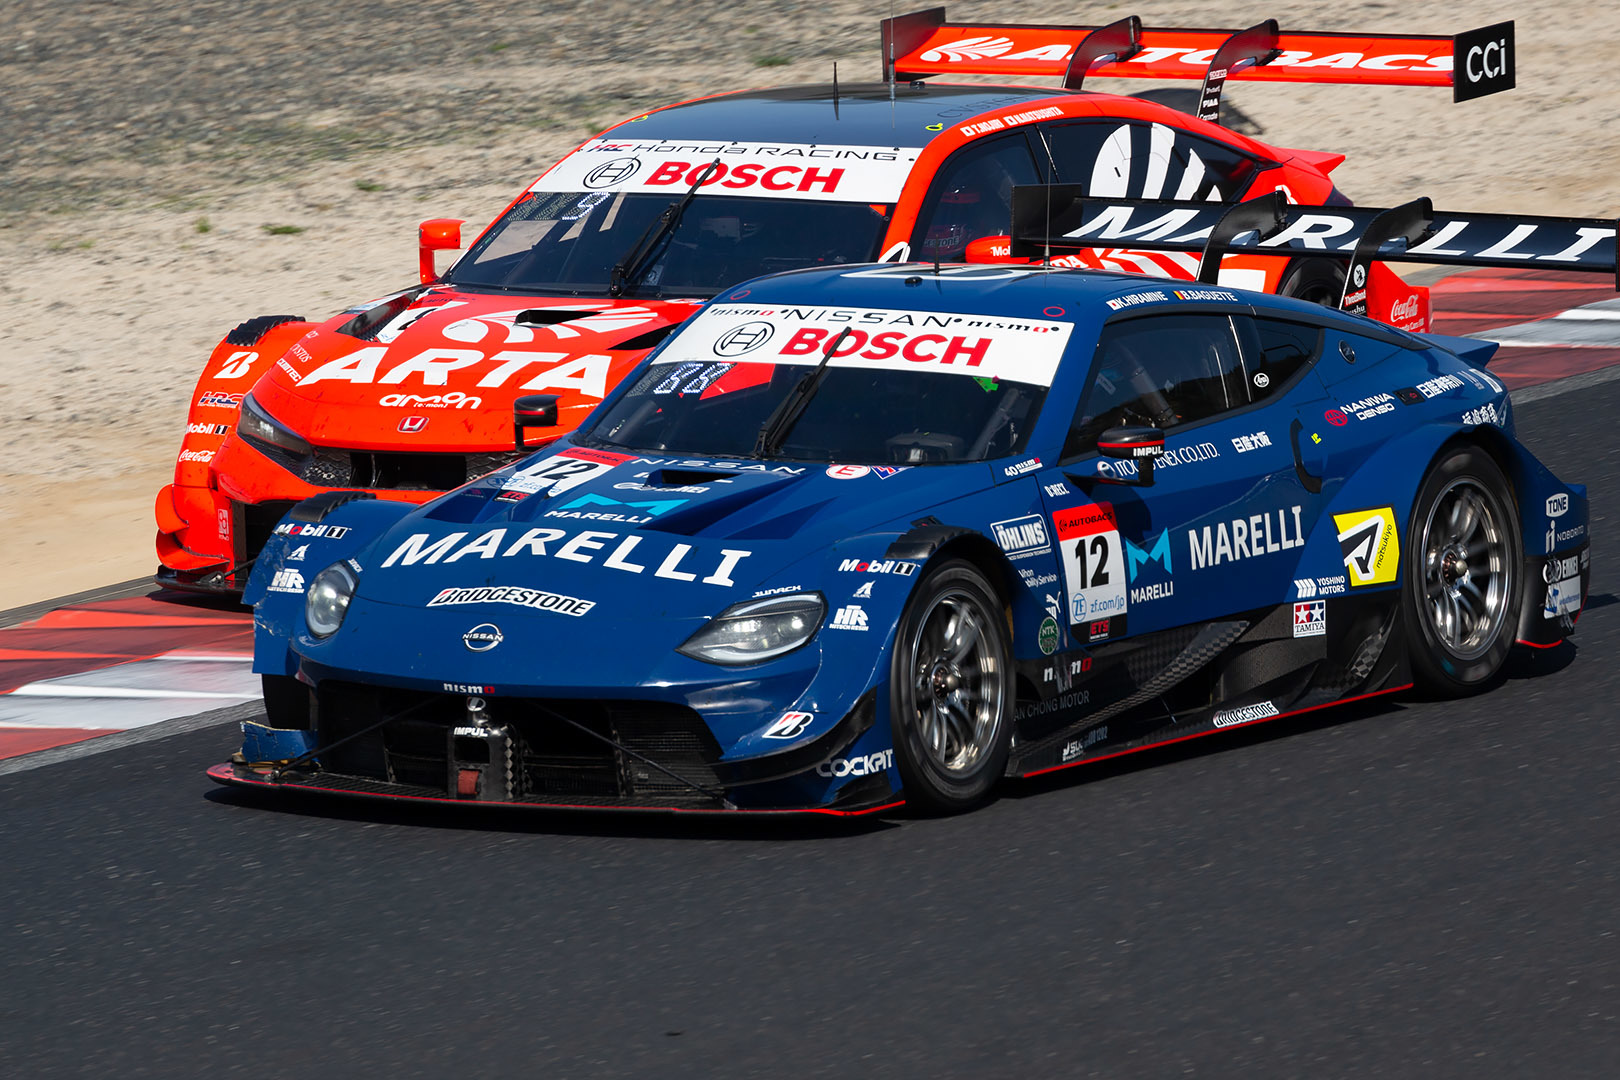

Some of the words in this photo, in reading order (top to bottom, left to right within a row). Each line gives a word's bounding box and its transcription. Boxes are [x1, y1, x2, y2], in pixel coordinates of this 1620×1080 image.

[632, 143, 748, 155] Honda
[755, 146, 898, 162] RACING
[643, 160, 846, 194] BOSCH
[1116, 290, 1169, 308] K.HIRAMINE
[1181, 290, 1239, 302] B.BAGUETTE
[786, 308, 957, 328] NISSAN
[967, 320, 1049, 334] nismo
[778, 327, 993, 367] BOSCH
[295, 346, 613, 399] ARTA
[1340, 392, 1396, 416] NANIWA
[1355, 402, 1396, 421] DENSO
[1133, 446, 1164, 457] IMPUL
[1231, 431, 1273, 454] 日産大阪
[530, 459, 600, 481] 12
[631, 457, 807, 475] NISSAN
[1547, 496, 1567, 515] TONE
[544, 510, 653, 524] MARELLI
[1068, 511, 1113, 529] AUTOBACS
[273, 523, 328, 537] Mobil
[995, 522, 1046, 551] ÖHLINS
[1189, 505, 1305, 571] MARELLI
[1376, 523, 1393, 569] matsukiyo
[380, 528, 752, 587] MARELLI
[838, 559, 895, 574] Mobil
[1074, 534, 1110, 590] 12
[1316, 575, 1346, 587] YOSHINO
[1318, 584, 1346, 596] MOTORS
[752, 585, 802, 598] JUNACK
[1130, 580, 1174, 605] MARELLI
[430, 587, 592, 617] BRIDGESTONE
[1090, 594, 1125, 614] zf.com/jp
[1091, 619, 1110, 635] ETS
[1294, 622, 1325, 633] TAMIYA
[463, 632, 504, 642] NISSAN
[443, 682, 496, 695] nismo
[1026, 696, 1058, 718] CHONG
[1060, 689, 1090, 710] MOTOR
[1214, 702, 1278, 727] BRIDGESTONE
[453, 726, 489, 738] IMPUL
[816, 748, 893, 778] COCKPIT
